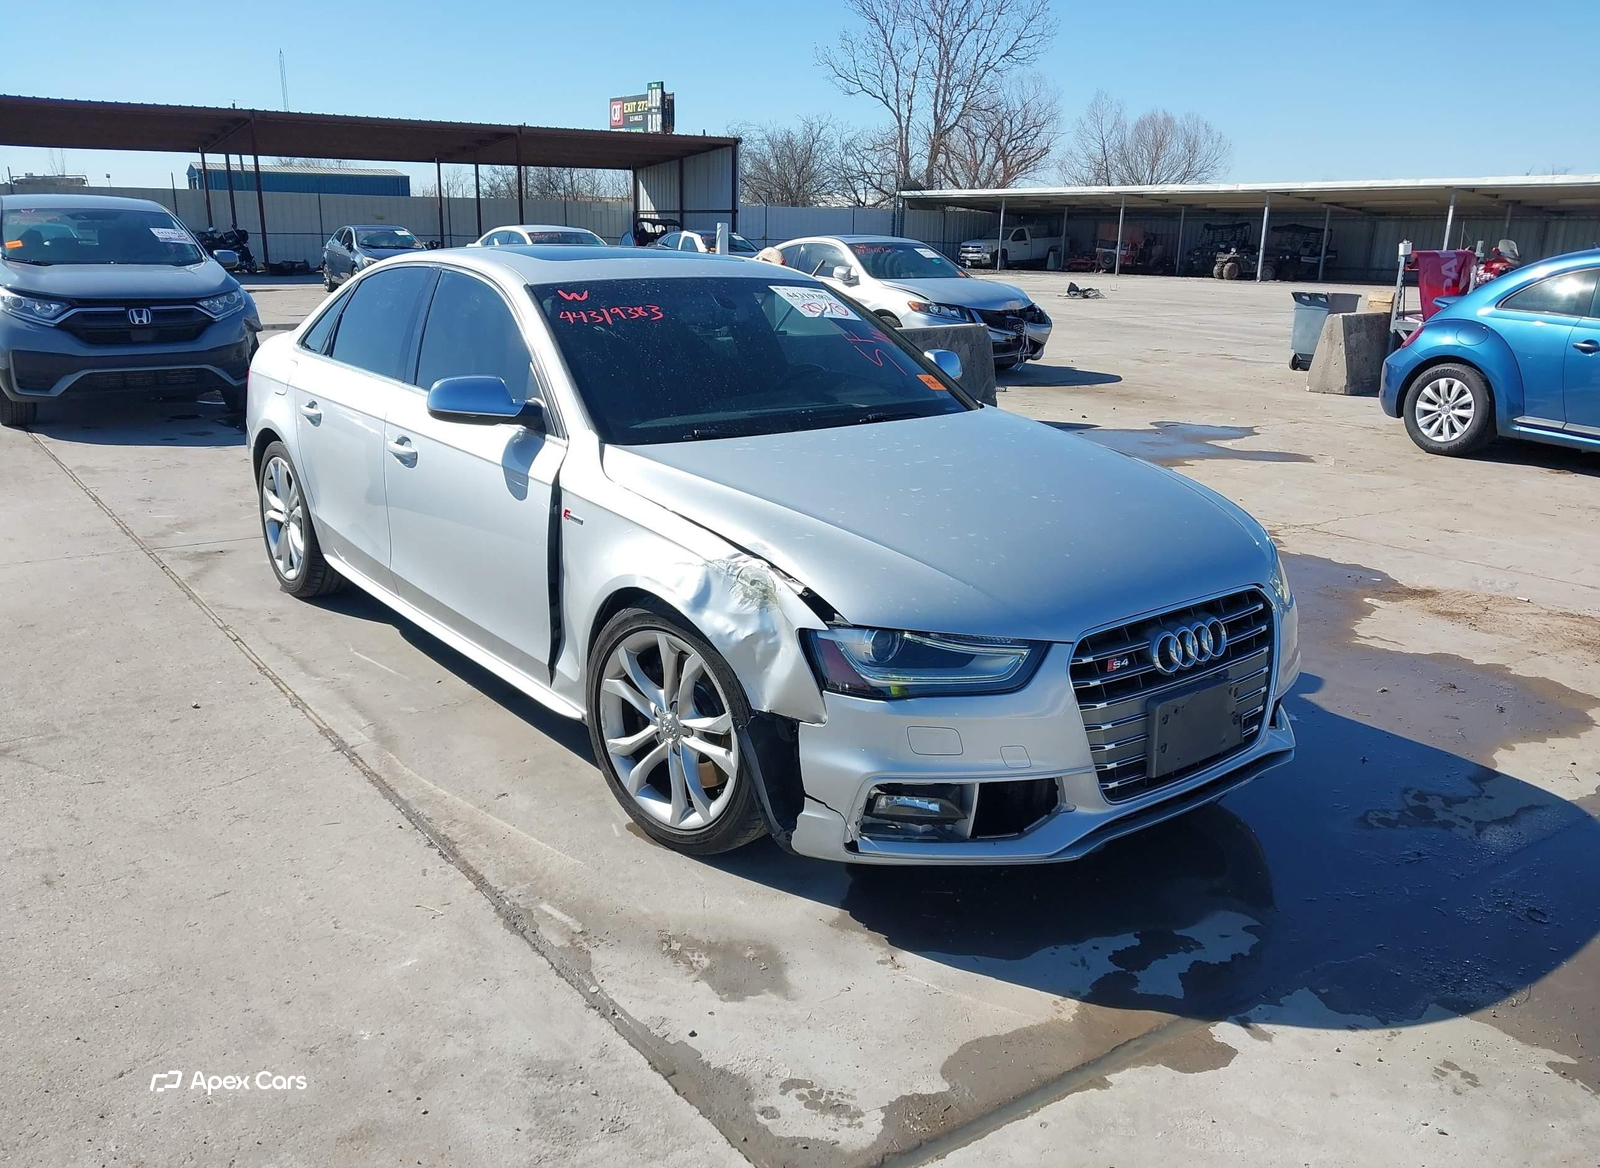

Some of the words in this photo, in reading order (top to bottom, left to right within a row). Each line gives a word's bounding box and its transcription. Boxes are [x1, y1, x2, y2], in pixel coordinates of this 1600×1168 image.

[623, 101, 637, 113] EXIT
[557, 289, 588, 301] W
[1110, 657, 1129, 670] S4
